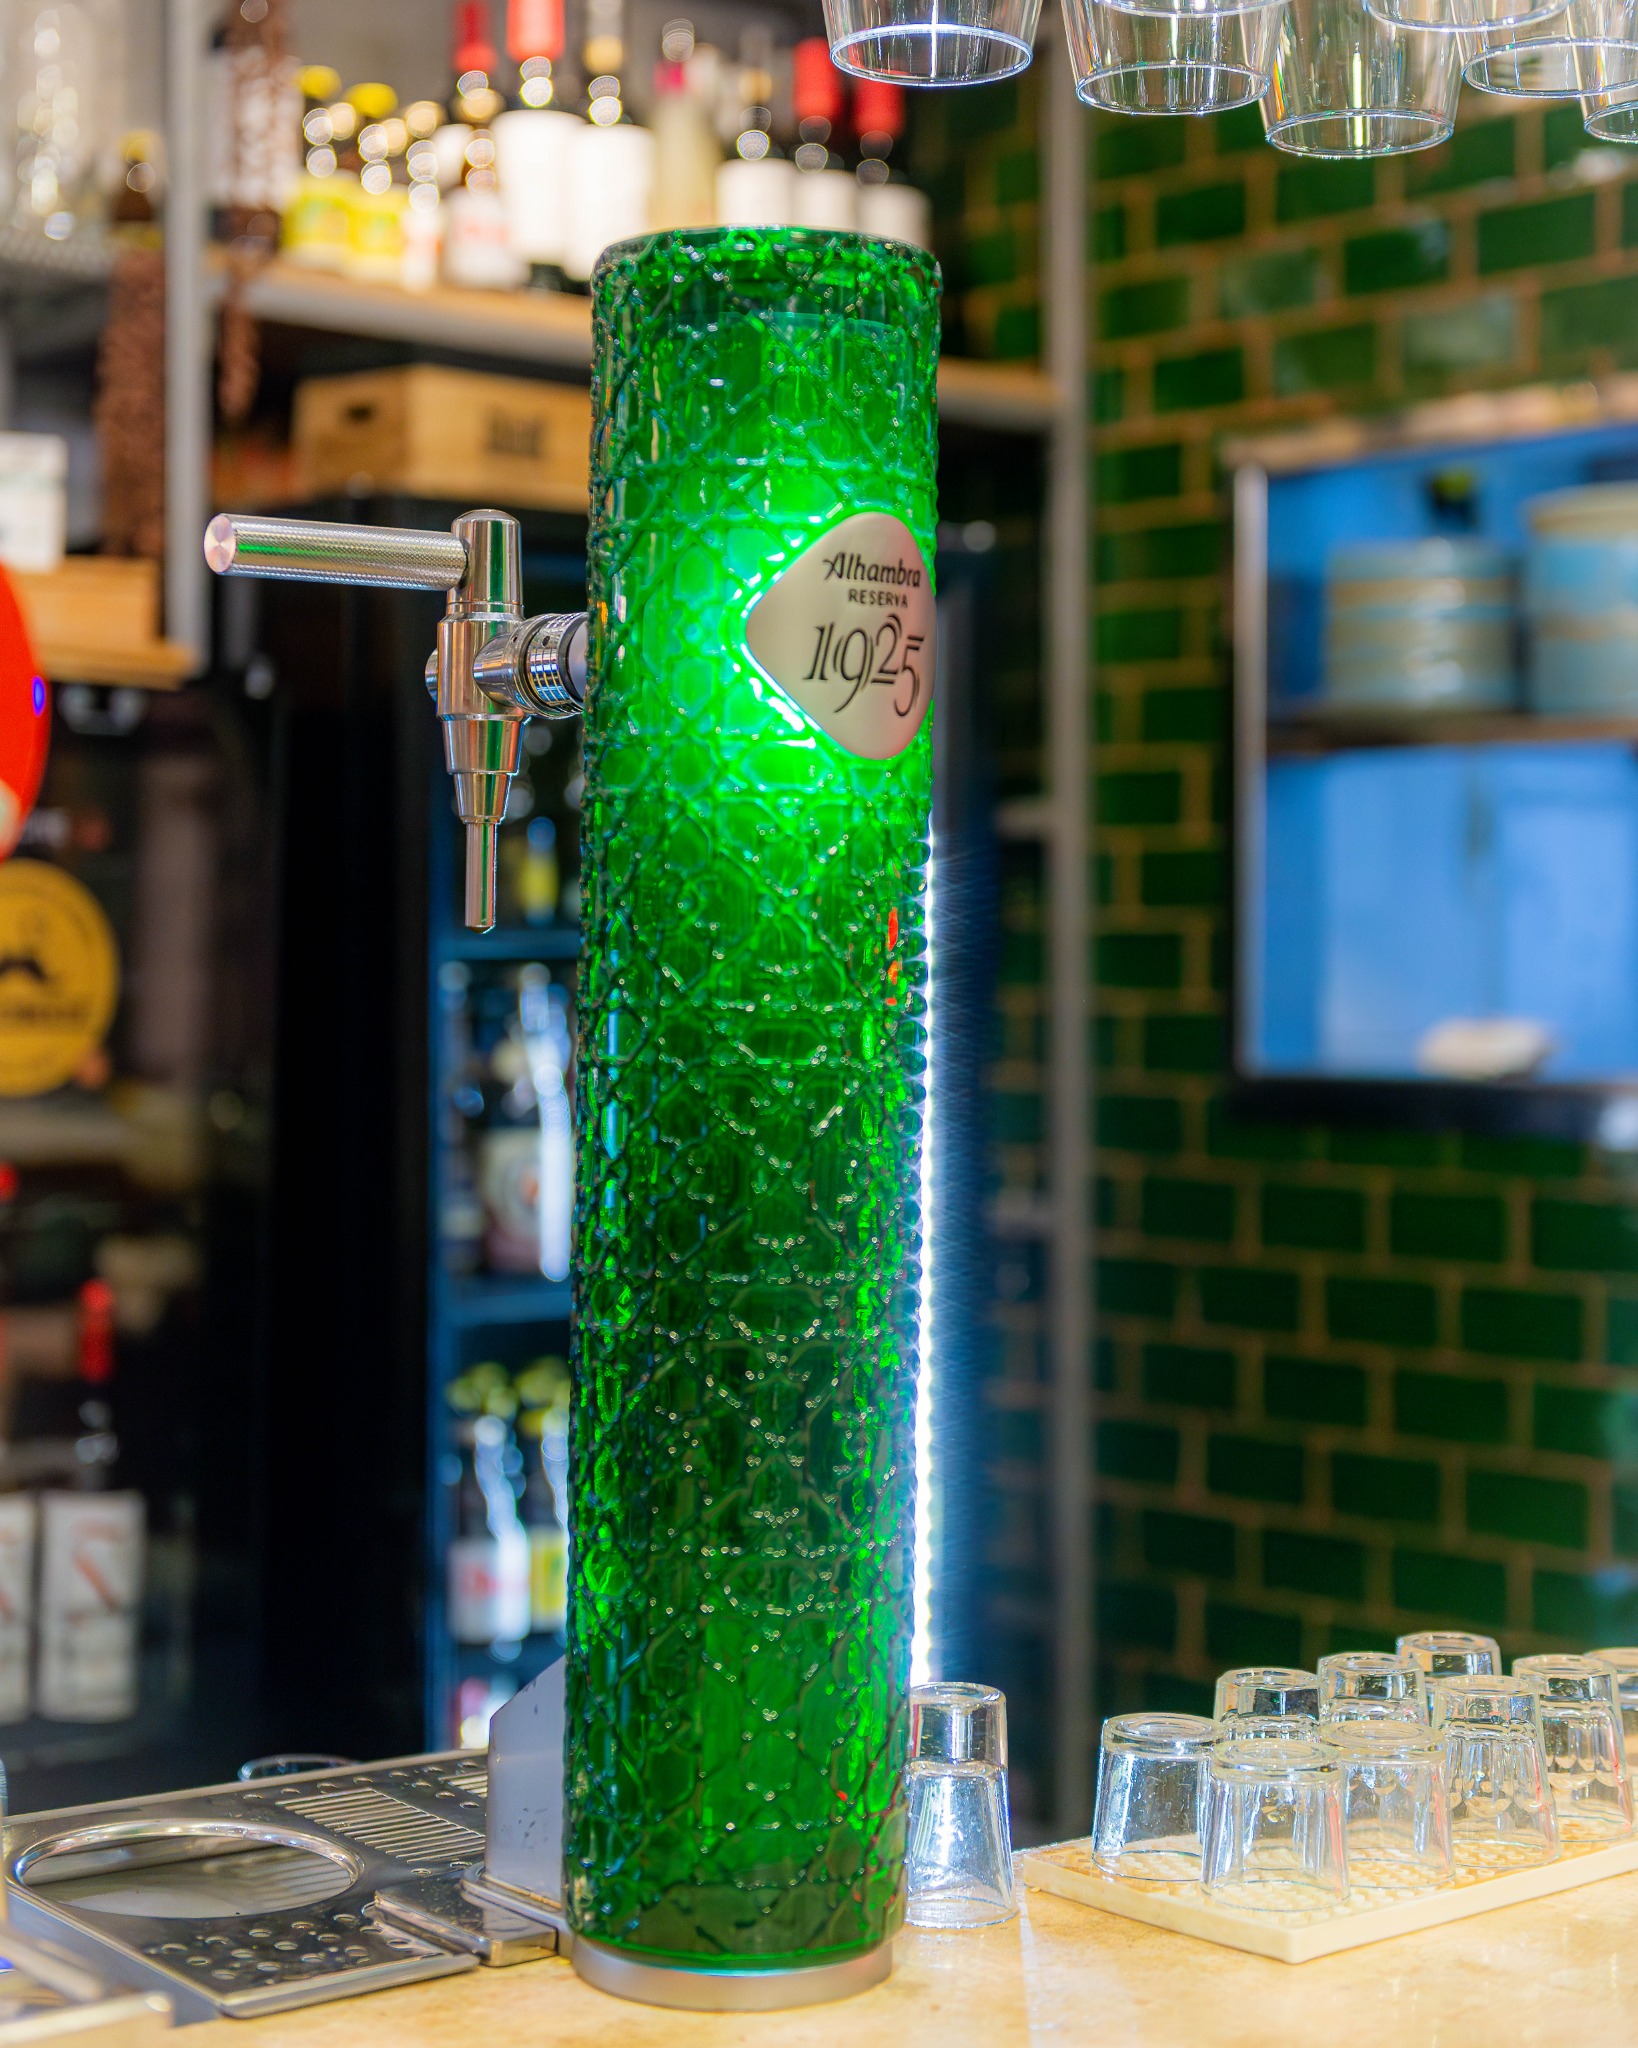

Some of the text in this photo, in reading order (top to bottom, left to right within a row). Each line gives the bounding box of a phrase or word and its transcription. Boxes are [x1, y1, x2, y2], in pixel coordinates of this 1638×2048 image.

[823, 551, 921, 588] Alhambra
[848, 588, 908, 608] RESERVA
[803, 613, 924, 717] 1925
